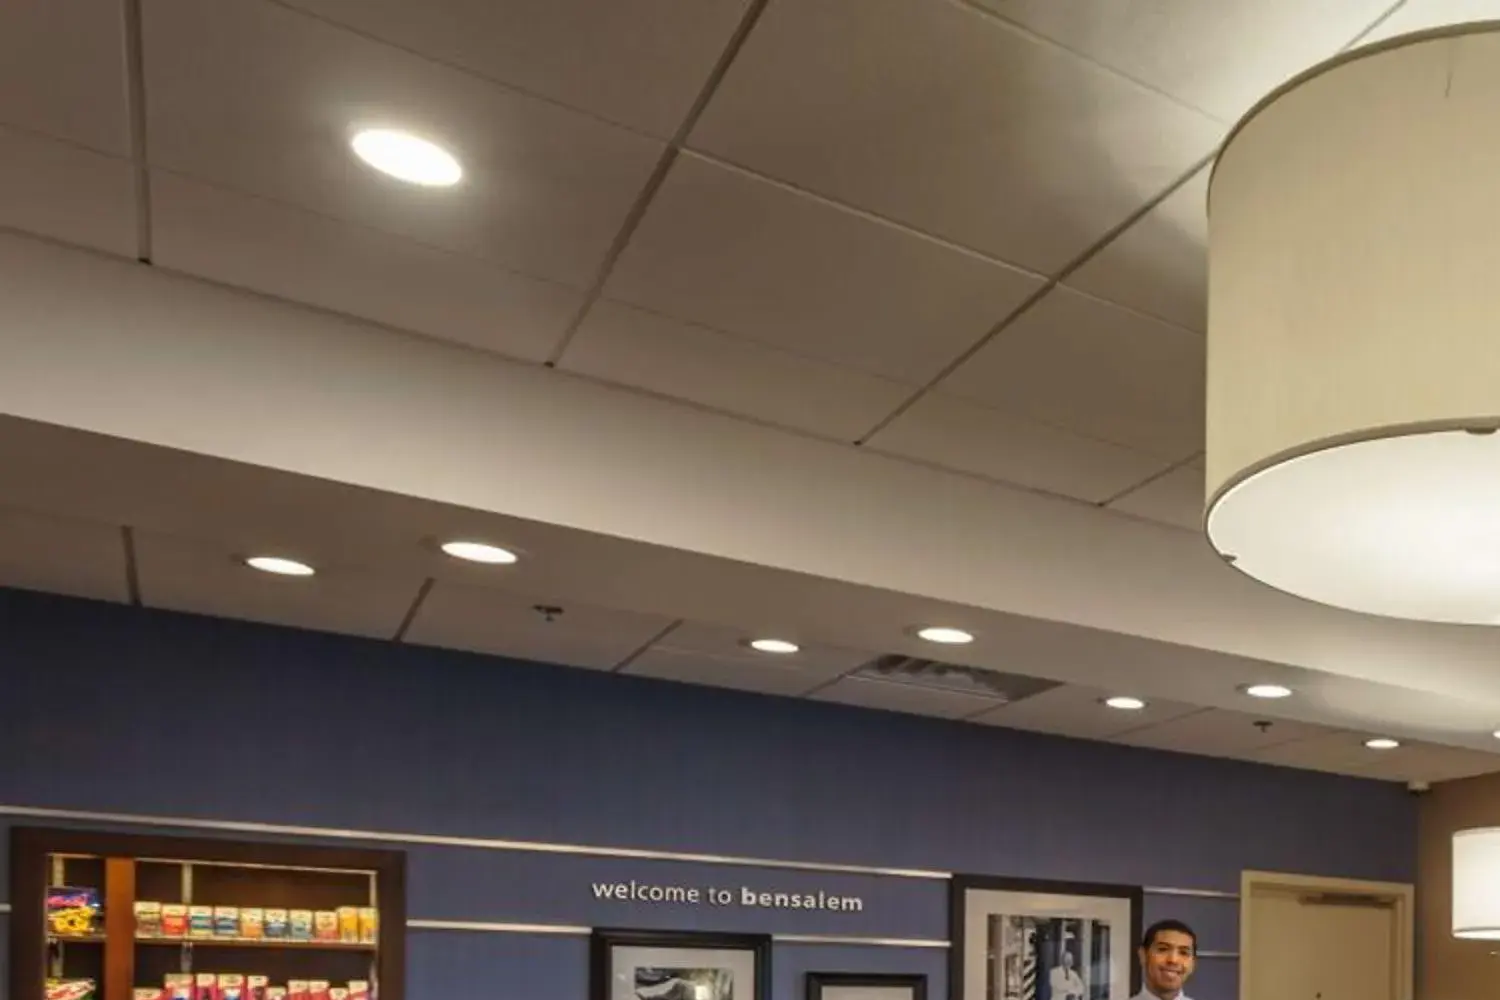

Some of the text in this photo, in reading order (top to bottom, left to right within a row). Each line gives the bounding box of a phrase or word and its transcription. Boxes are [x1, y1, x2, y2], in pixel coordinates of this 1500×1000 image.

[592, 880, 863, 911] welcome to bensalem
